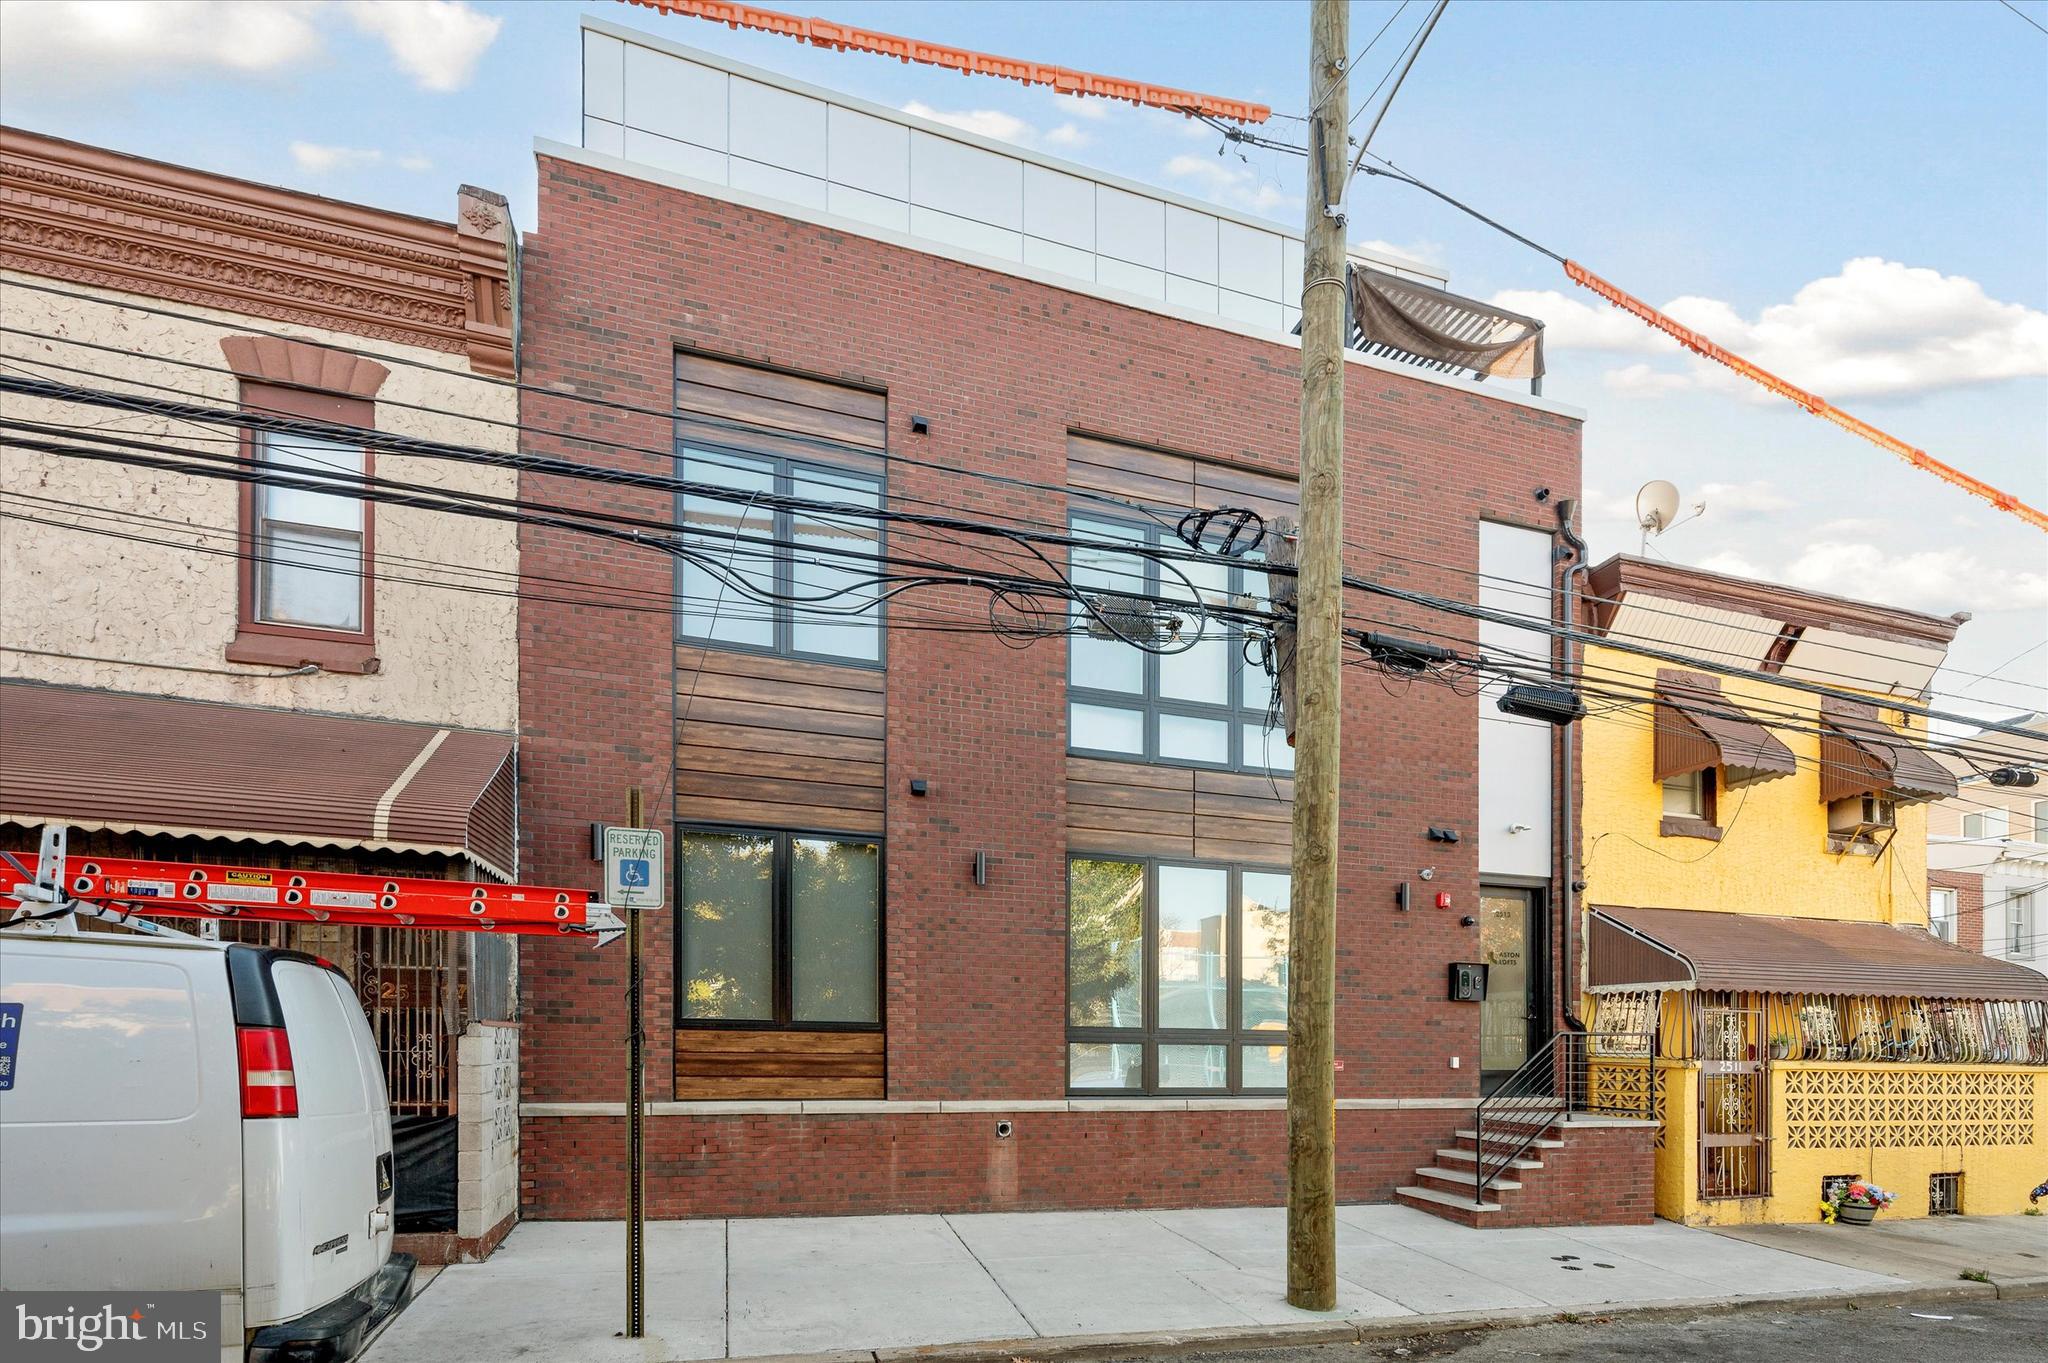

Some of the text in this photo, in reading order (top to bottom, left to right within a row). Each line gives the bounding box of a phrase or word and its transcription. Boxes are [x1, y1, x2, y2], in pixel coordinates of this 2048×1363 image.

[610, 834, 659, 846] RESERVED
[613, 847, 656, 859] PARKING
[231, 871, 268, 880] CAUTION
[1719, 1061, 1742, 1071] 2511
